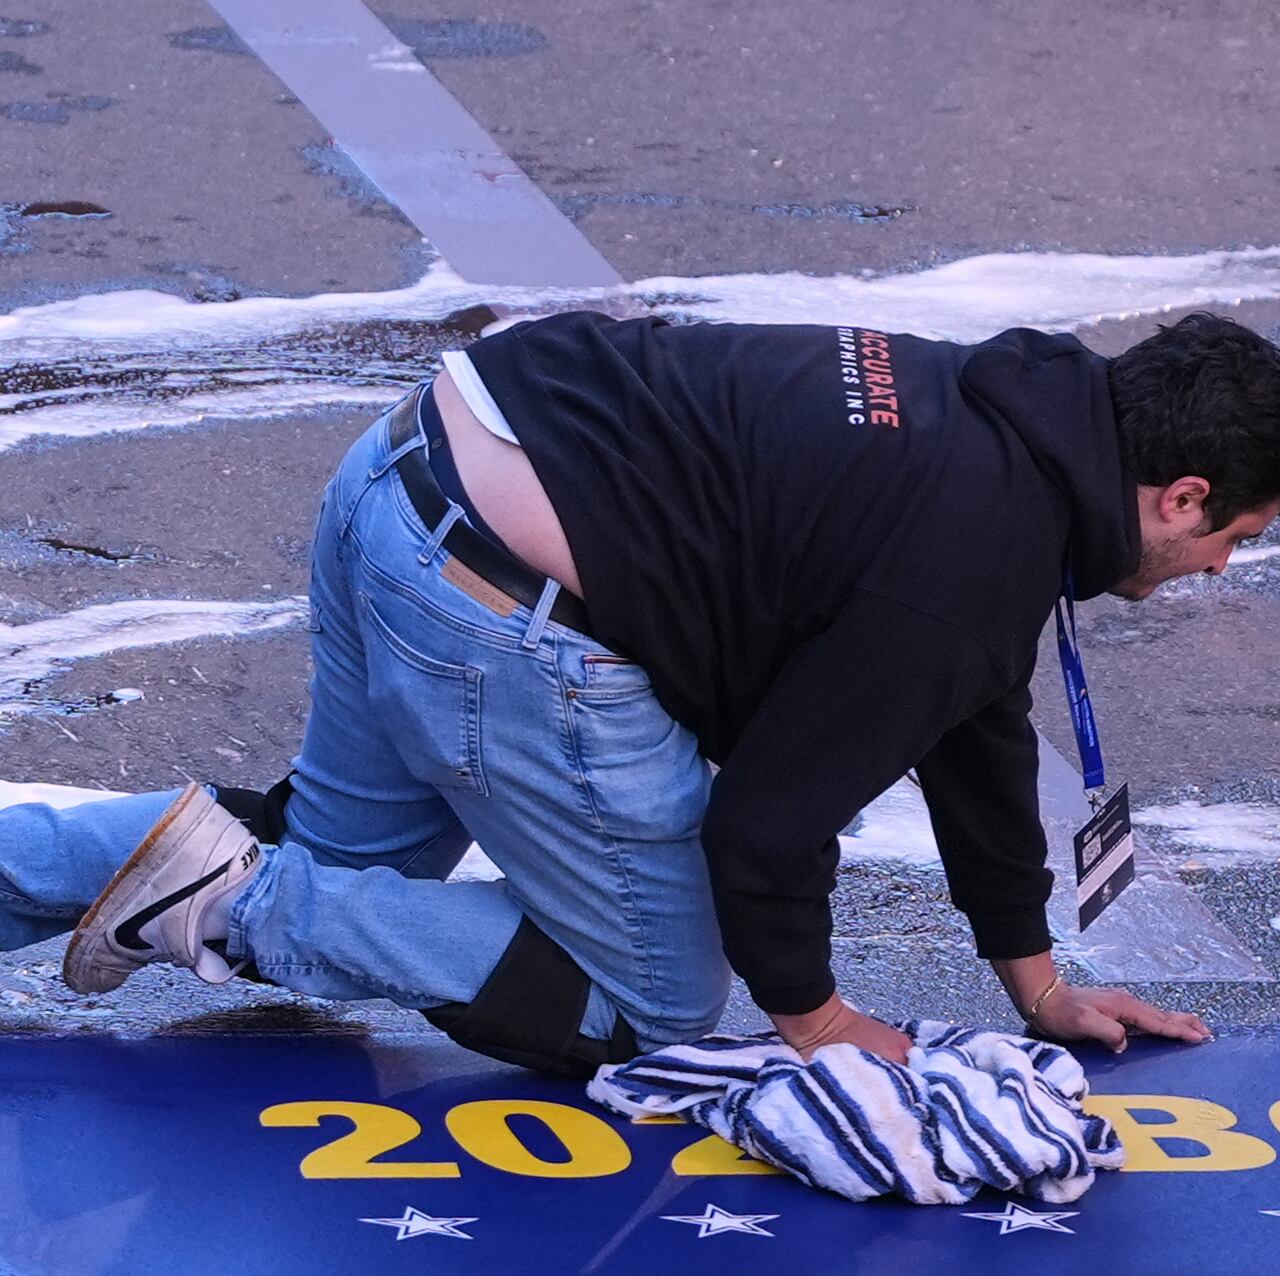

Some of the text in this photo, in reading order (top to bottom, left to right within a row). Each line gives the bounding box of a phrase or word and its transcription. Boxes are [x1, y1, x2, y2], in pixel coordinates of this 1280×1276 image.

[860, 330, 899, 428] ACCURATE
[845, 391, 866, 425] INC
[241, 841, 260, 871] NIKE
[260, 1100, 788, 1179] 20
